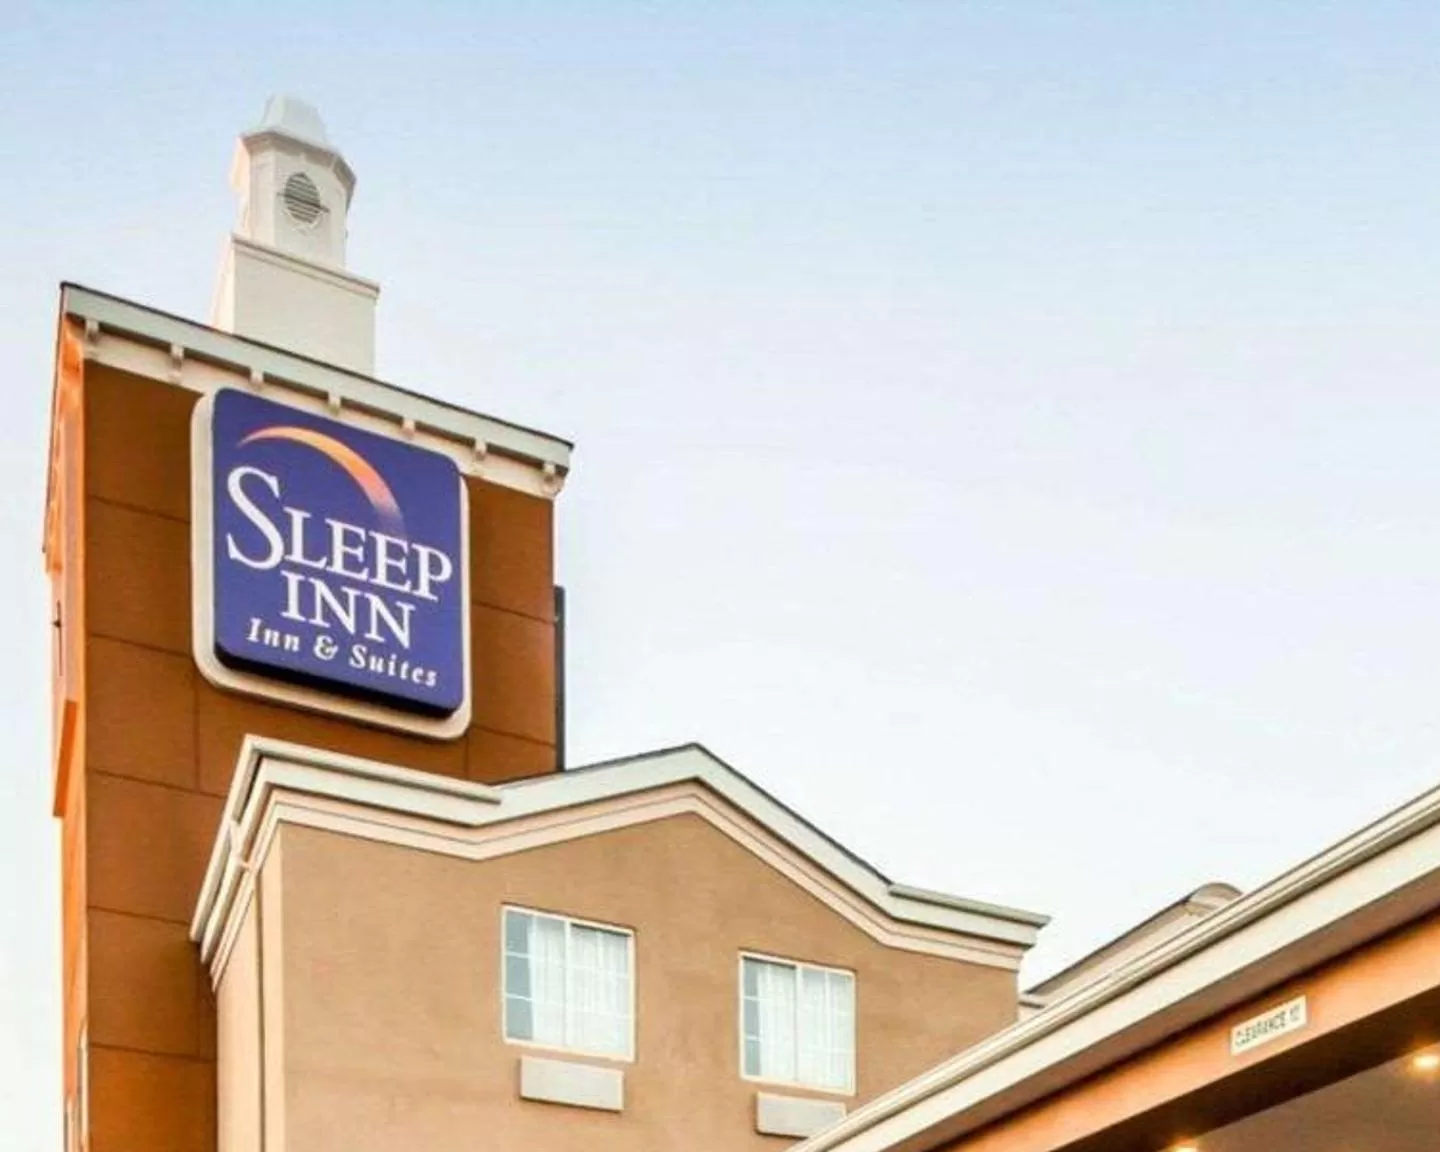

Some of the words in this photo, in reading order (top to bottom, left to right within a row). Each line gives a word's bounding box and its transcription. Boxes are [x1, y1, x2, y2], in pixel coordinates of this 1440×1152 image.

[226, 466, 453, 601] SLEEP
[280, 569, 416, 650] INN
[246, 617, 300, 652] Inn
[313, 635, 339, 661] &
[349, 643, 438, 688] Suites
